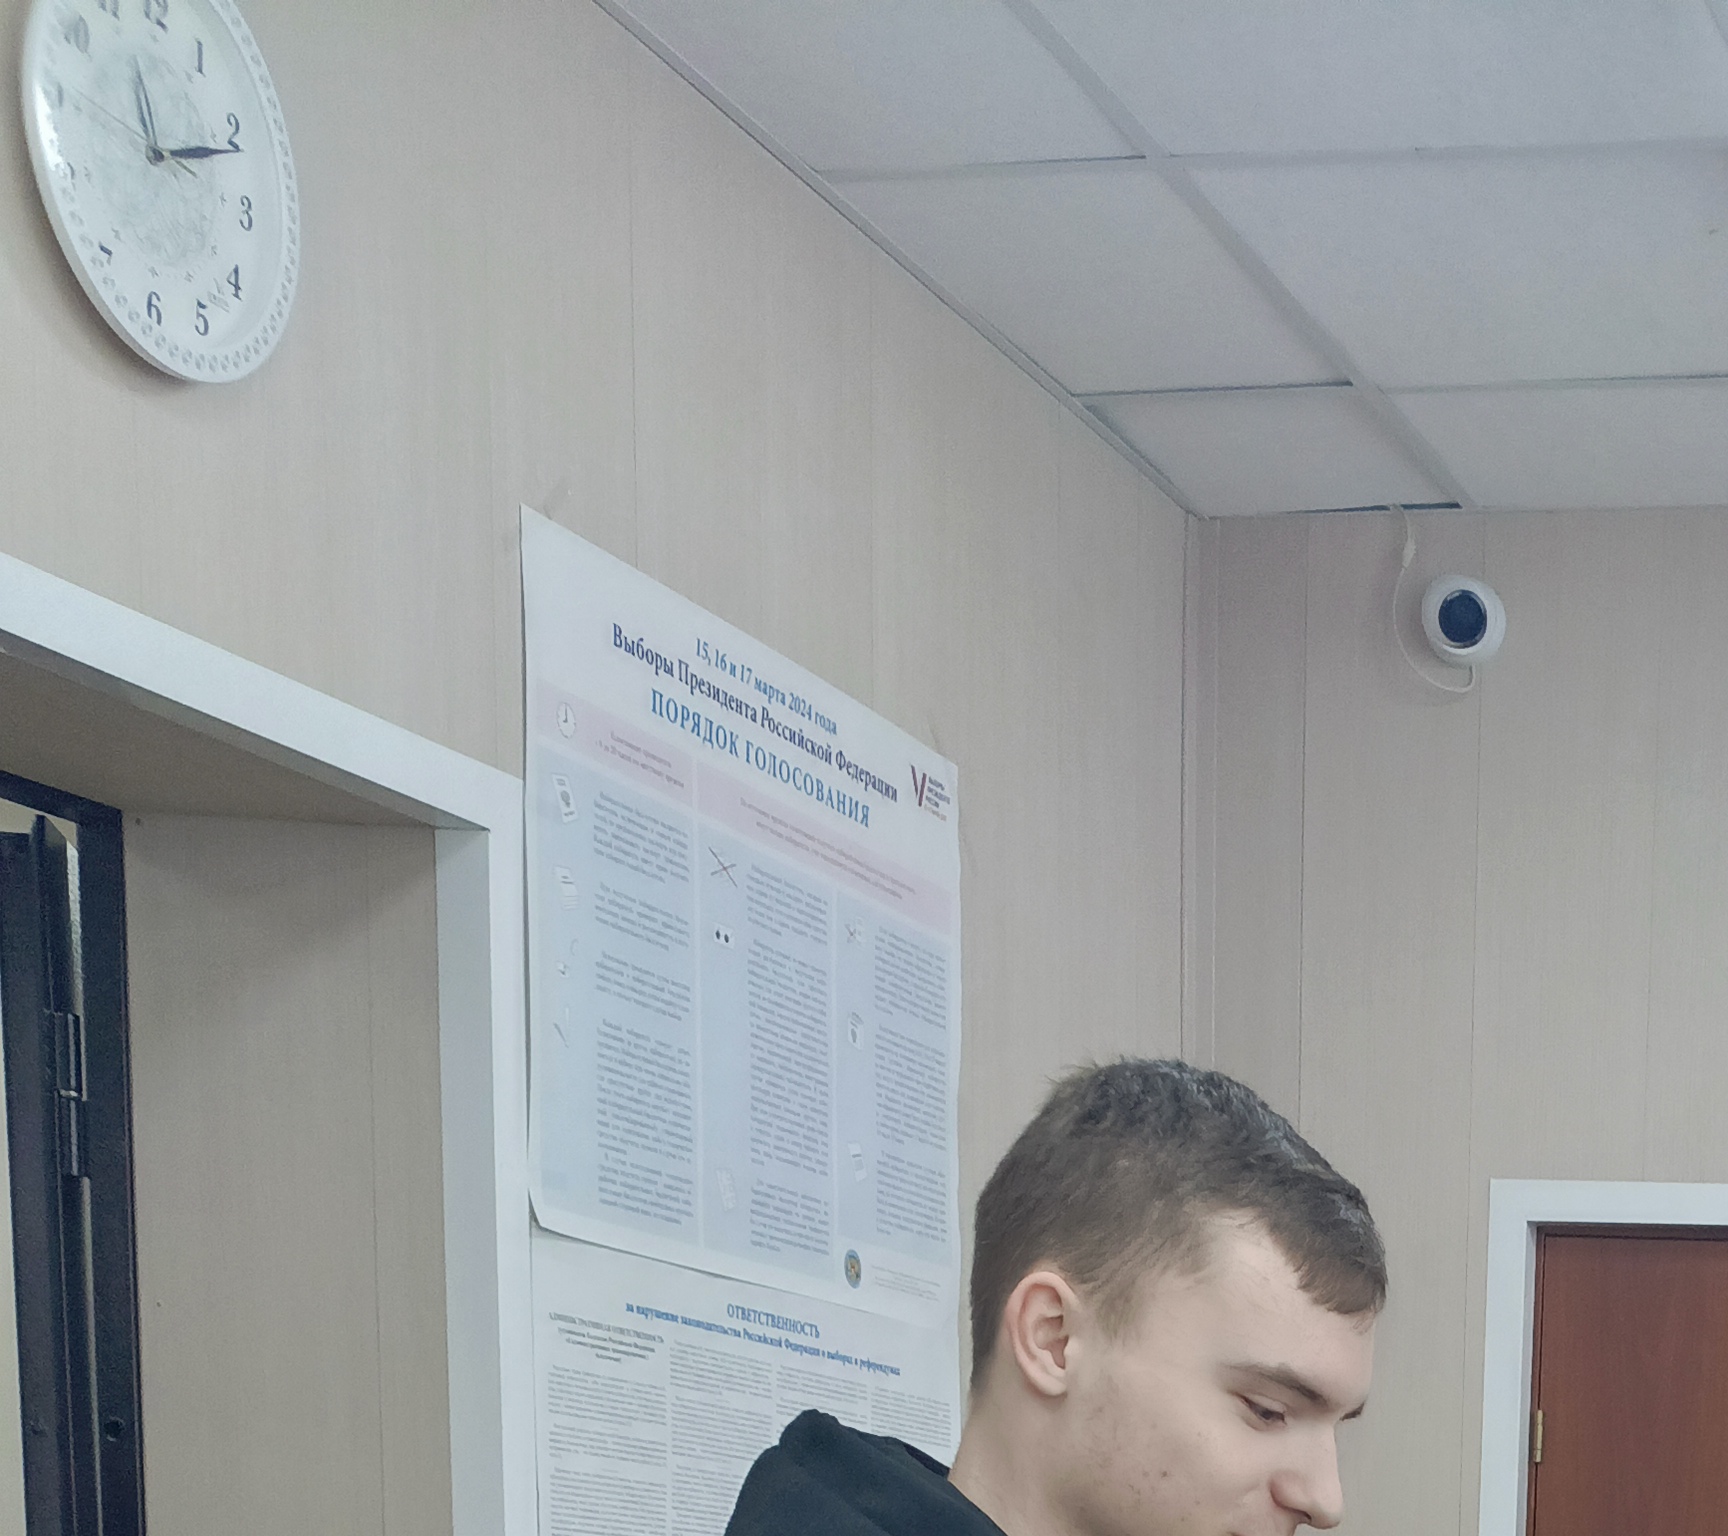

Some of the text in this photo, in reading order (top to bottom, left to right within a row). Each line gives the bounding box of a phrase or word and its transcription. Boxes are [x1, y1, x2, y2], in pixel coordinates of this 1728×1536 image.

[194, 37, 206, 77] 1
[227, 112, 242, 151] 2
[239, 195, 253, 232] 3
[226, 264, 243, 301] 4
[146, 291, 162, 326] 6
[194, 299, 209, 336] 5
[715, 648, 727, 672] 16
[729, 660, 737, 678] и
[740, 664, 753, 684] 17
[754, 676, 786, 706] марта
[788, 692, 813, 721] 2024
[814, 711, 838, 736] года
[612, 622, 675, 678] Выборы
[677, 658, 758, 724] Президента
[760, 705, 833, 766] Российской
[835, 749, 898, 803] Федерации
[651, 687, 740, 758] ПОРЯДОК
[745, 739, 870, 829] ГОЛОСОВАНИЯ
[726, 1302, 821, 1339] ОТВЕТСТВЕННОСТЬ
